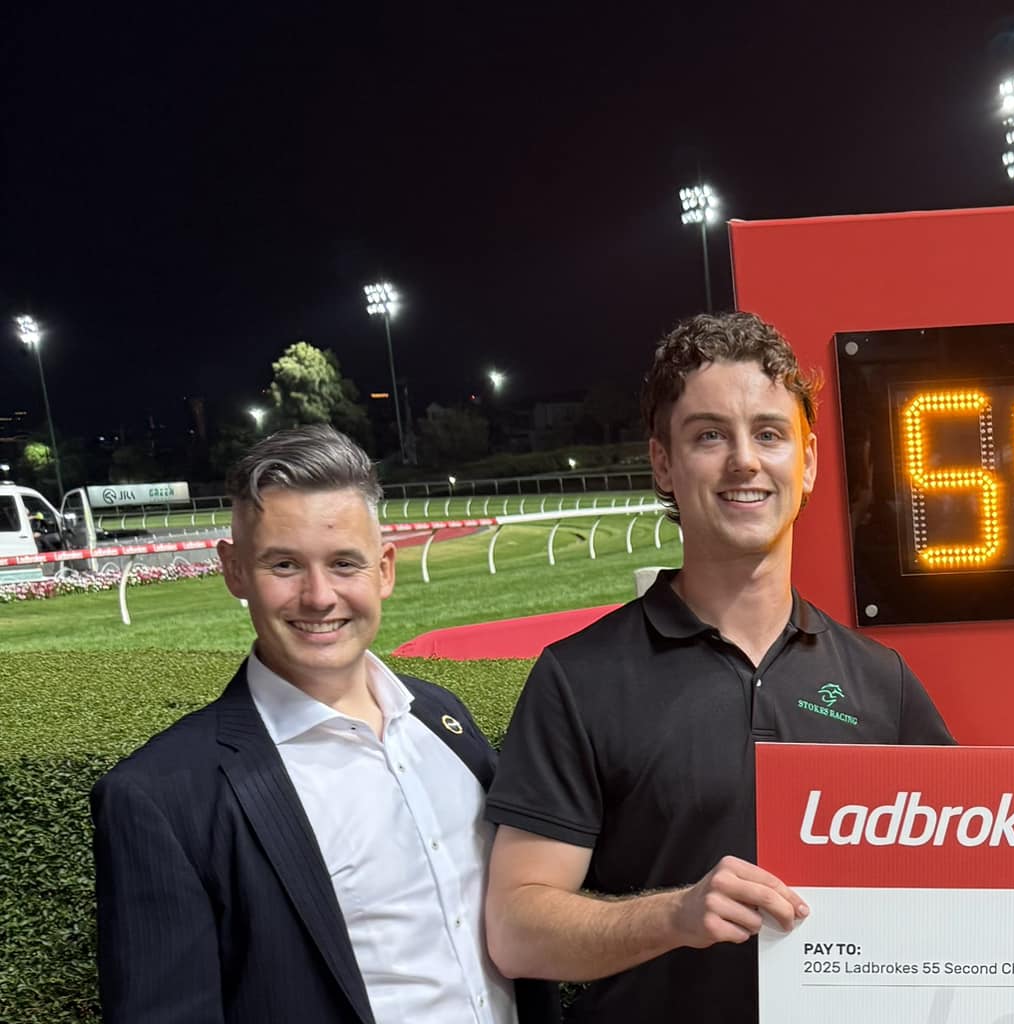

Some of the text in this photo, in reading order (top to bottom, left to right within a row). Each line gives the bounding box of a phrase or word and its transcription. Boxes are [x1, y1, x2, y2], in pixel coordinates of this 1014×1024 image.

[797, 699, 858, 725] STOKES RACING
[804, 943, 861, 956] PAY TO:
[803, 961, 841, 974] 2025
[845, 961, 919, 975] Ladbrokes
[922, 962, 941, 975] 55
[944, 962, 998, 975] Second
